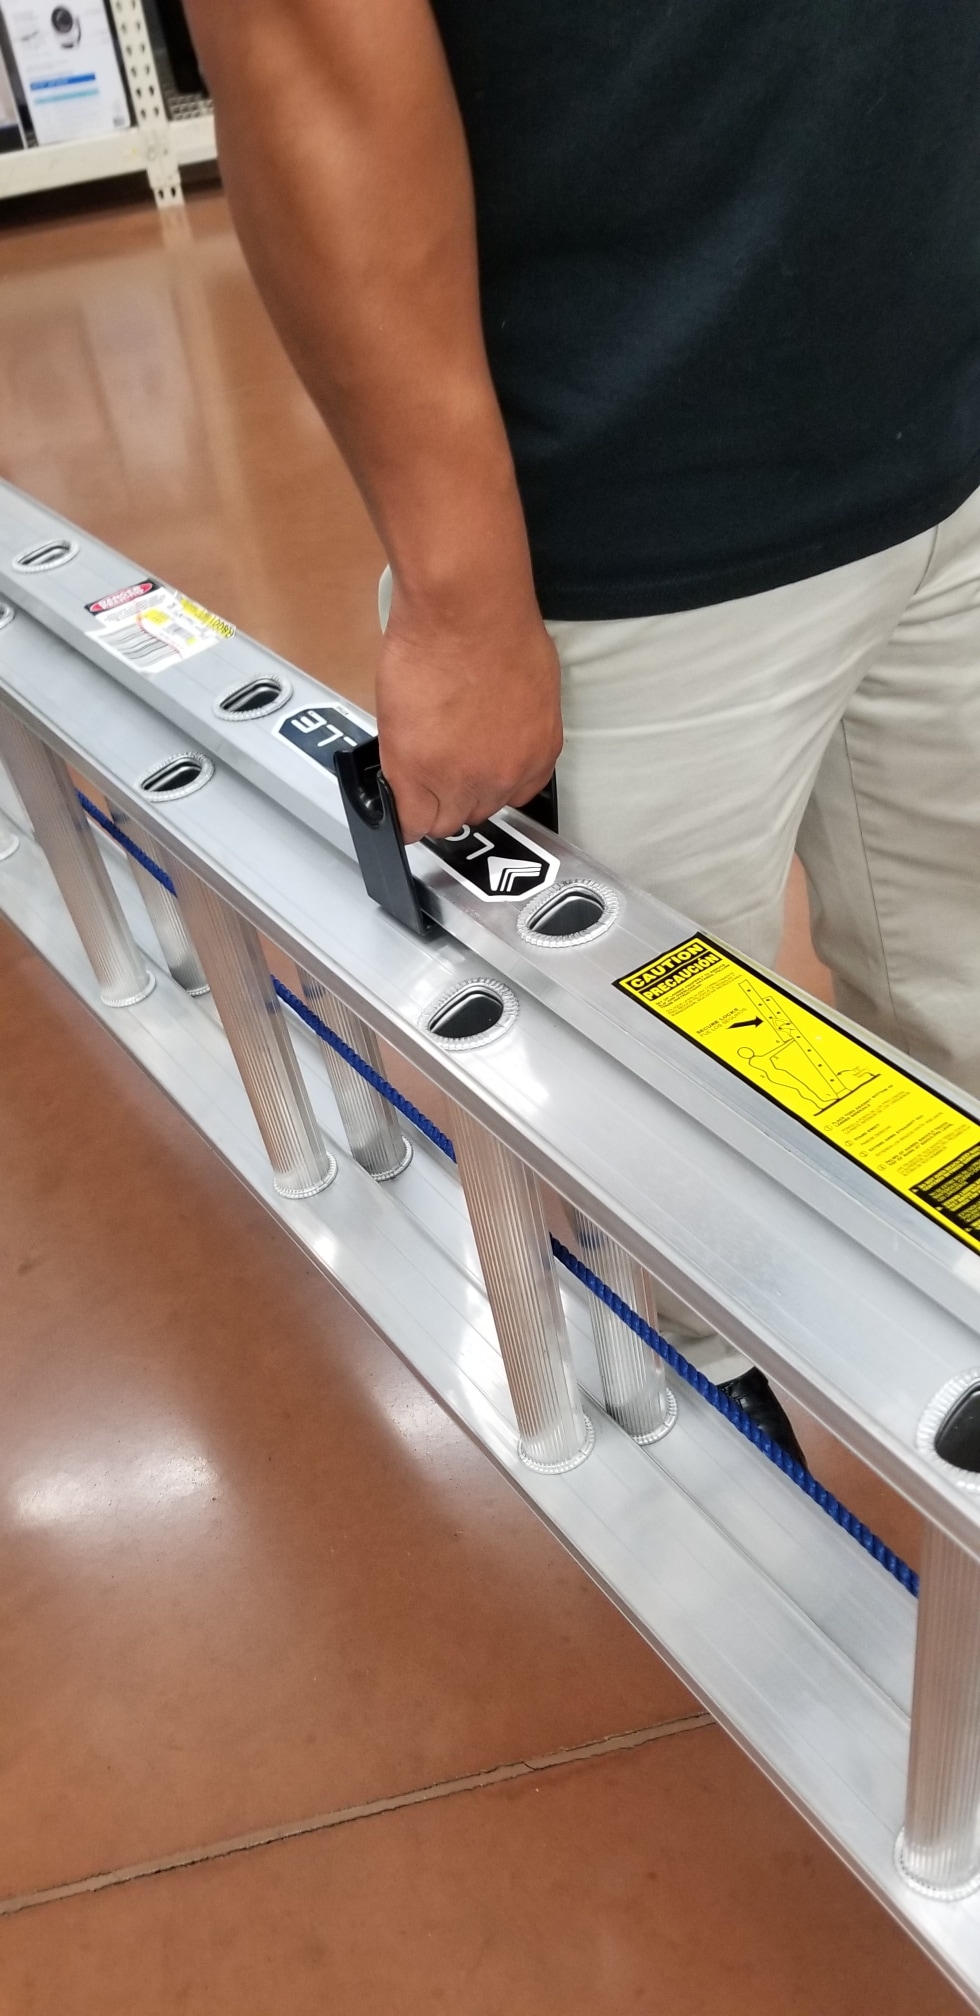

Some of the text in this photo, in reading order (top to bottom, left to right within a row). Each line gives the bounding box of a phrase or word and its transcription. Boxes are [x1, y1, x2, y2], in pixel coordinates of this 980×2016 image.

[630, 944, 704, 988] CAUTION
[642, 954, 720, 1000] PRECAUCIÓN
[696, 1008, 739, 1034] SECURE LOCKS
